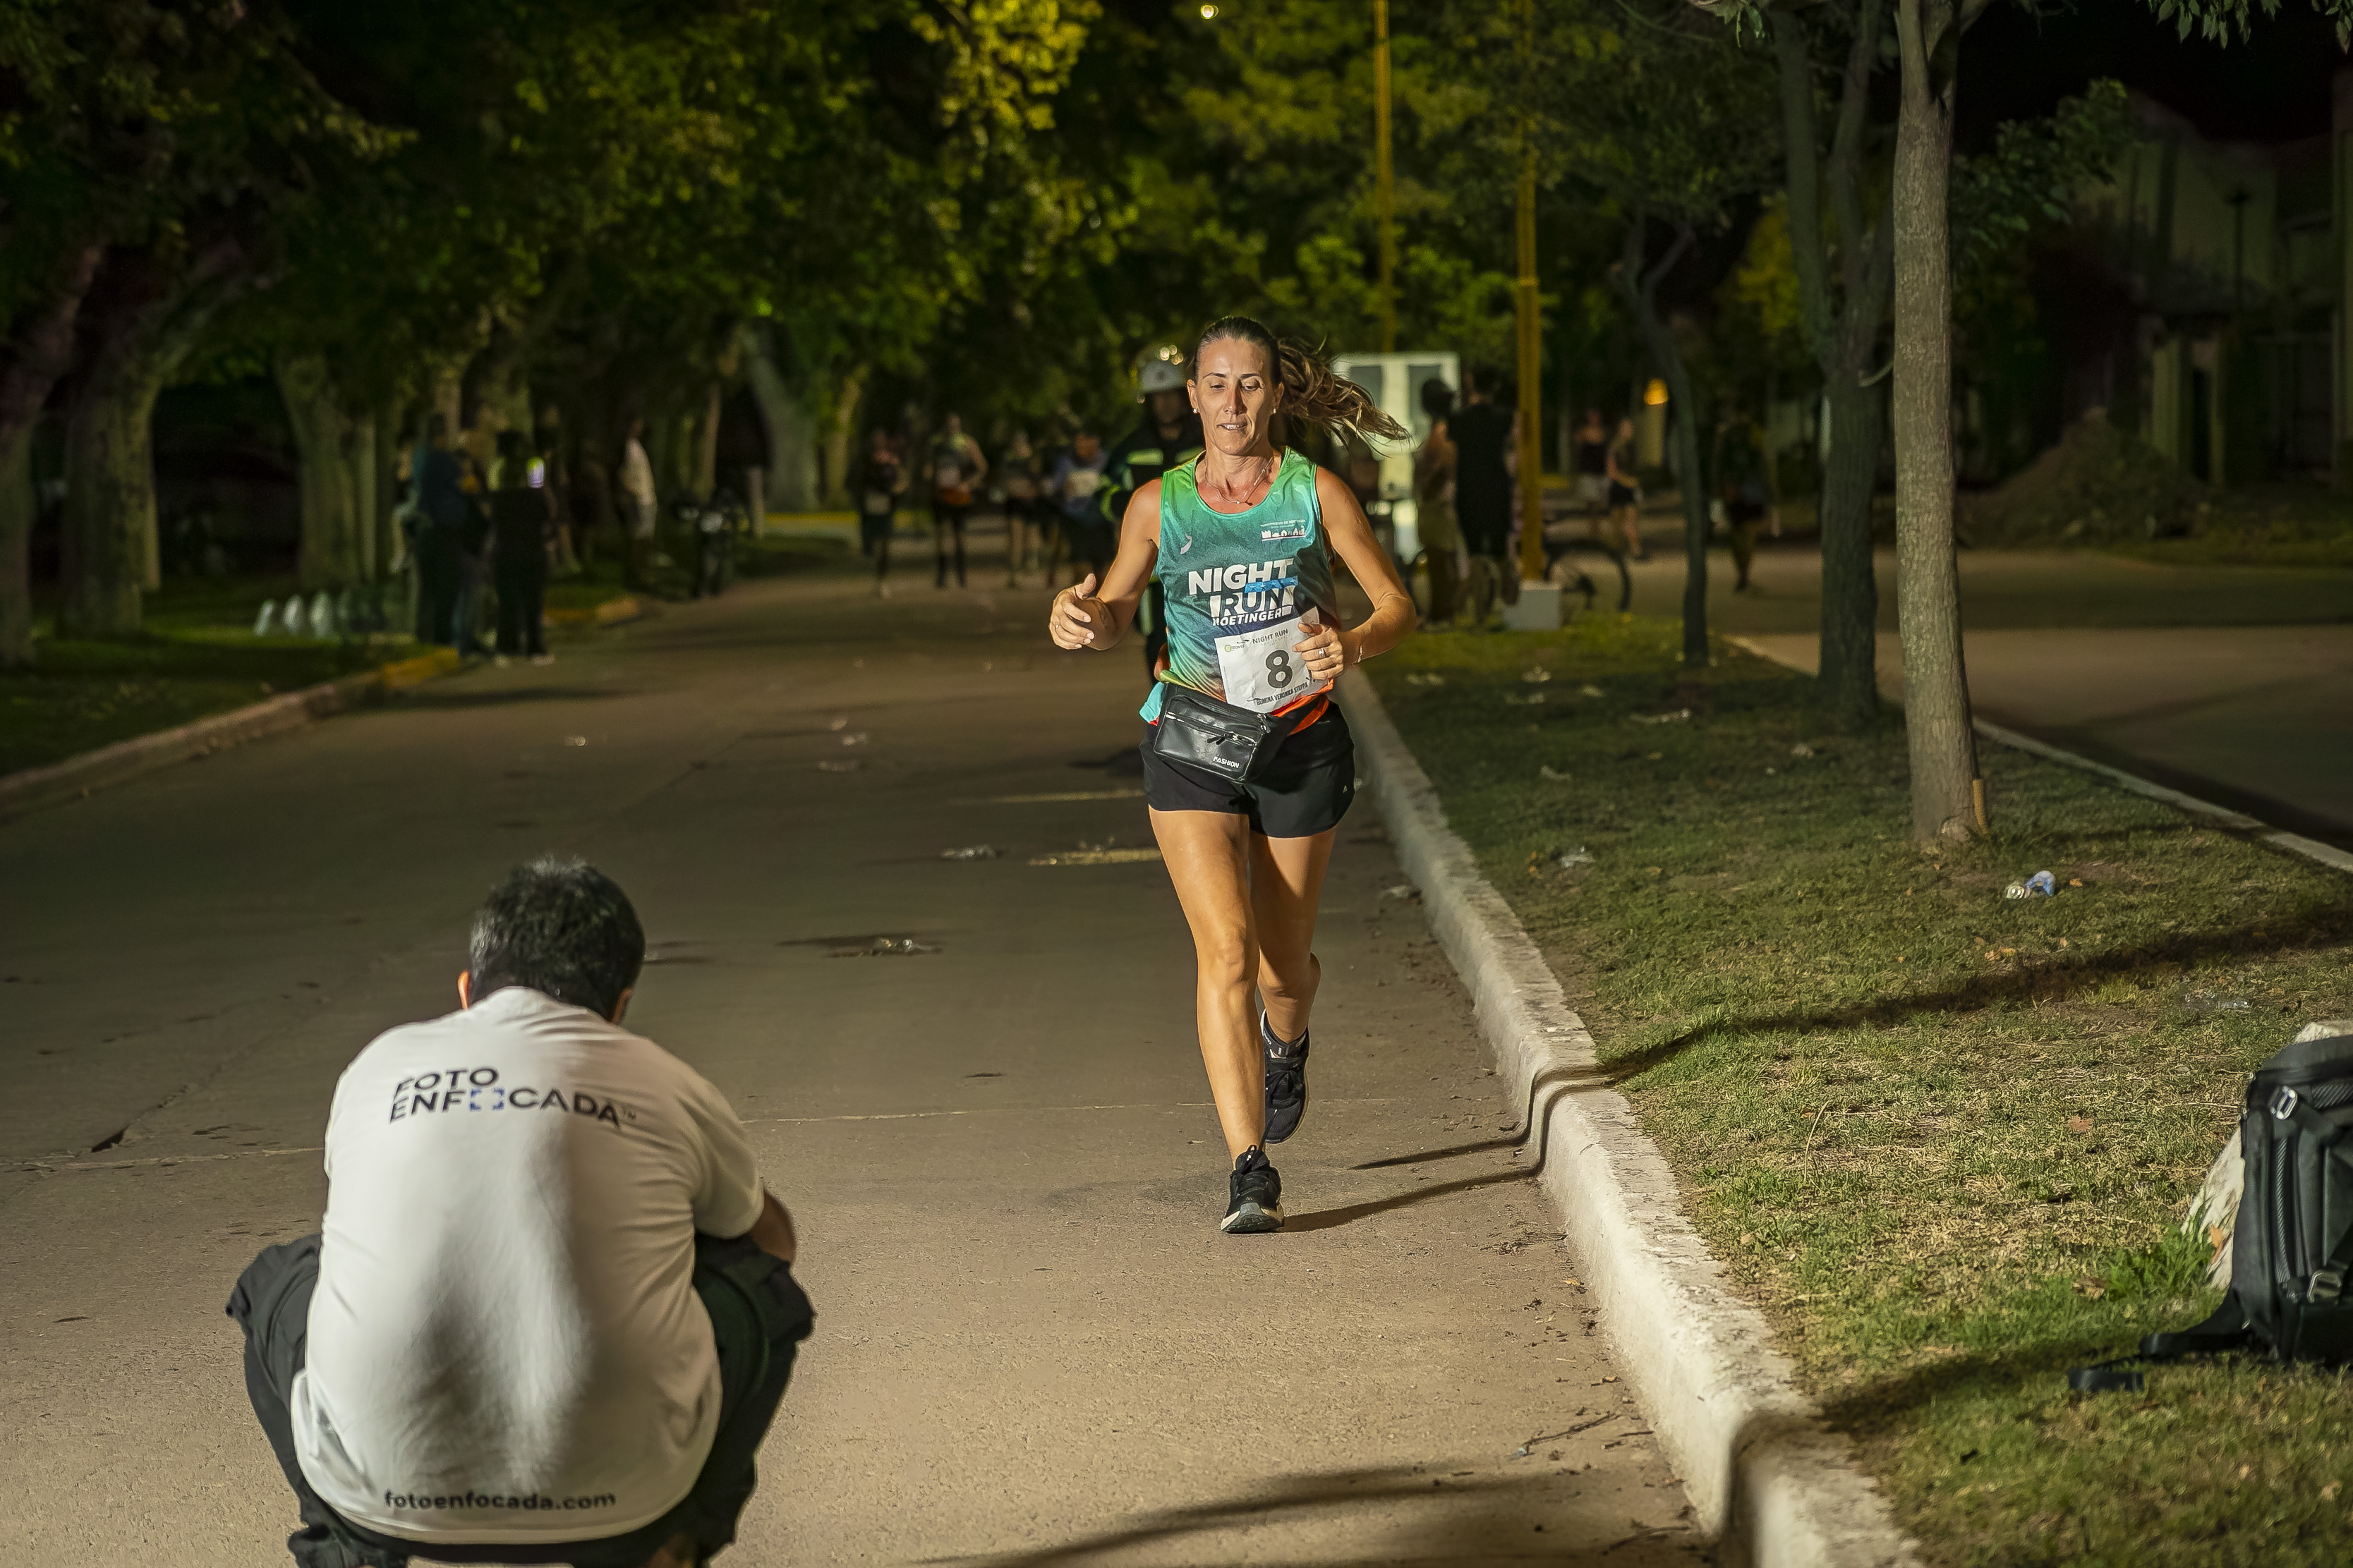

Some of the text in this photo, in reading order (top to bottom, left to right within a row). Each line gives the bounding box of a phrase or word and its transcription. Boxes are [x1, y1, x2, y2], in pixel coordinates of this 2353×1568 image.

[1188, 557, 1295, 595] NIGHT
[1209, 585, 1295, 618] RUN
[1252, 633, 1274, 645] NIGHT
[1275, 628, 1288, 638] RUN
[1265, 649, 1293, 688] 8
[1213, 755, 1240, 769] FASHION
[393, 1067, 500, 1102] FOTO
[385, 1489, 617, 1509] fotoenfocada.com
